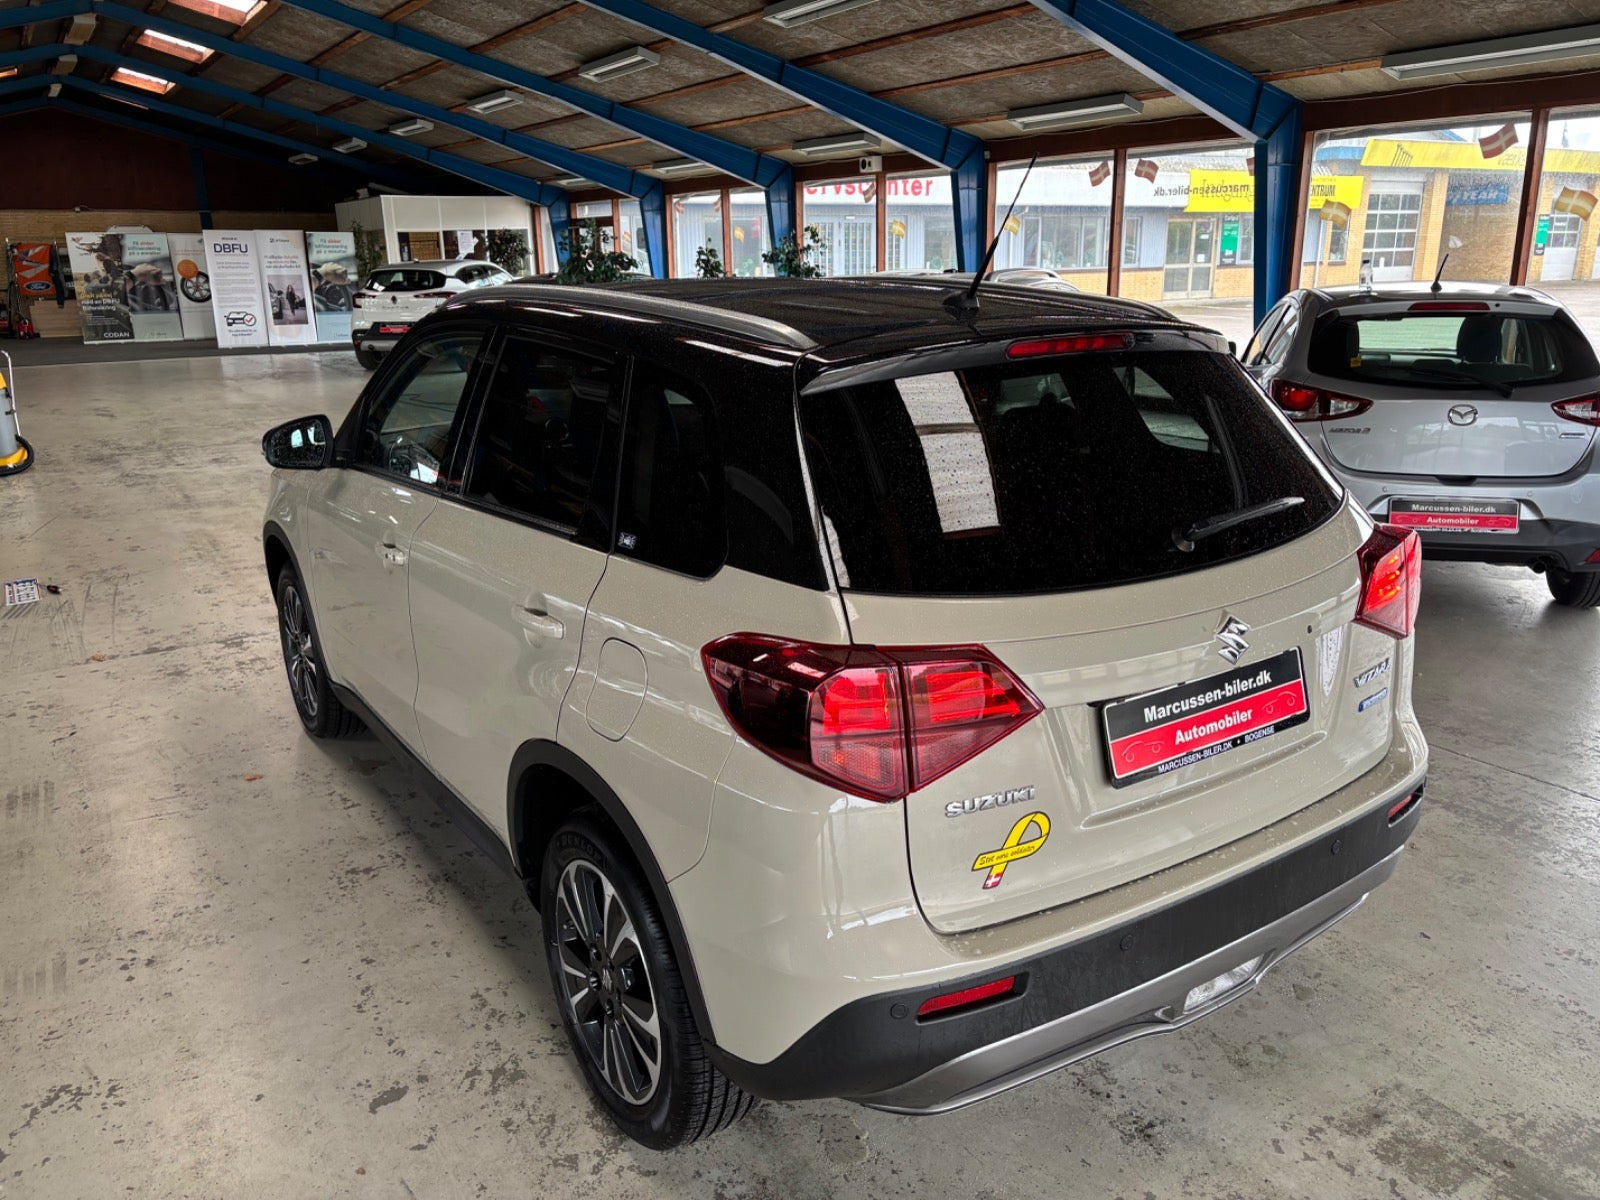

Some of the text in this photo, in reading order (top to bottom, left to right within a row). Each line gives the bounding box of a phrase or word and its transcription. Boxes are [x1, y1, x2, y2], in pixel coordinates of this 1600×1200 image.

[213, 243, 249, 253] DBFU
[1411, 503, 1497, 514] Marcussen-biler.dk
[1426, 516, 1480, 526] Automobiler
[1143, 670, 1273, 724] Marcussen-biler.dk
[1174, 708, 1253, 745] Automobiler
[1157, 725, 1276, 775] MARCUSSEN-BILER.DK BOGENSE
[945, 785, 1036, 818] SUZUKI
